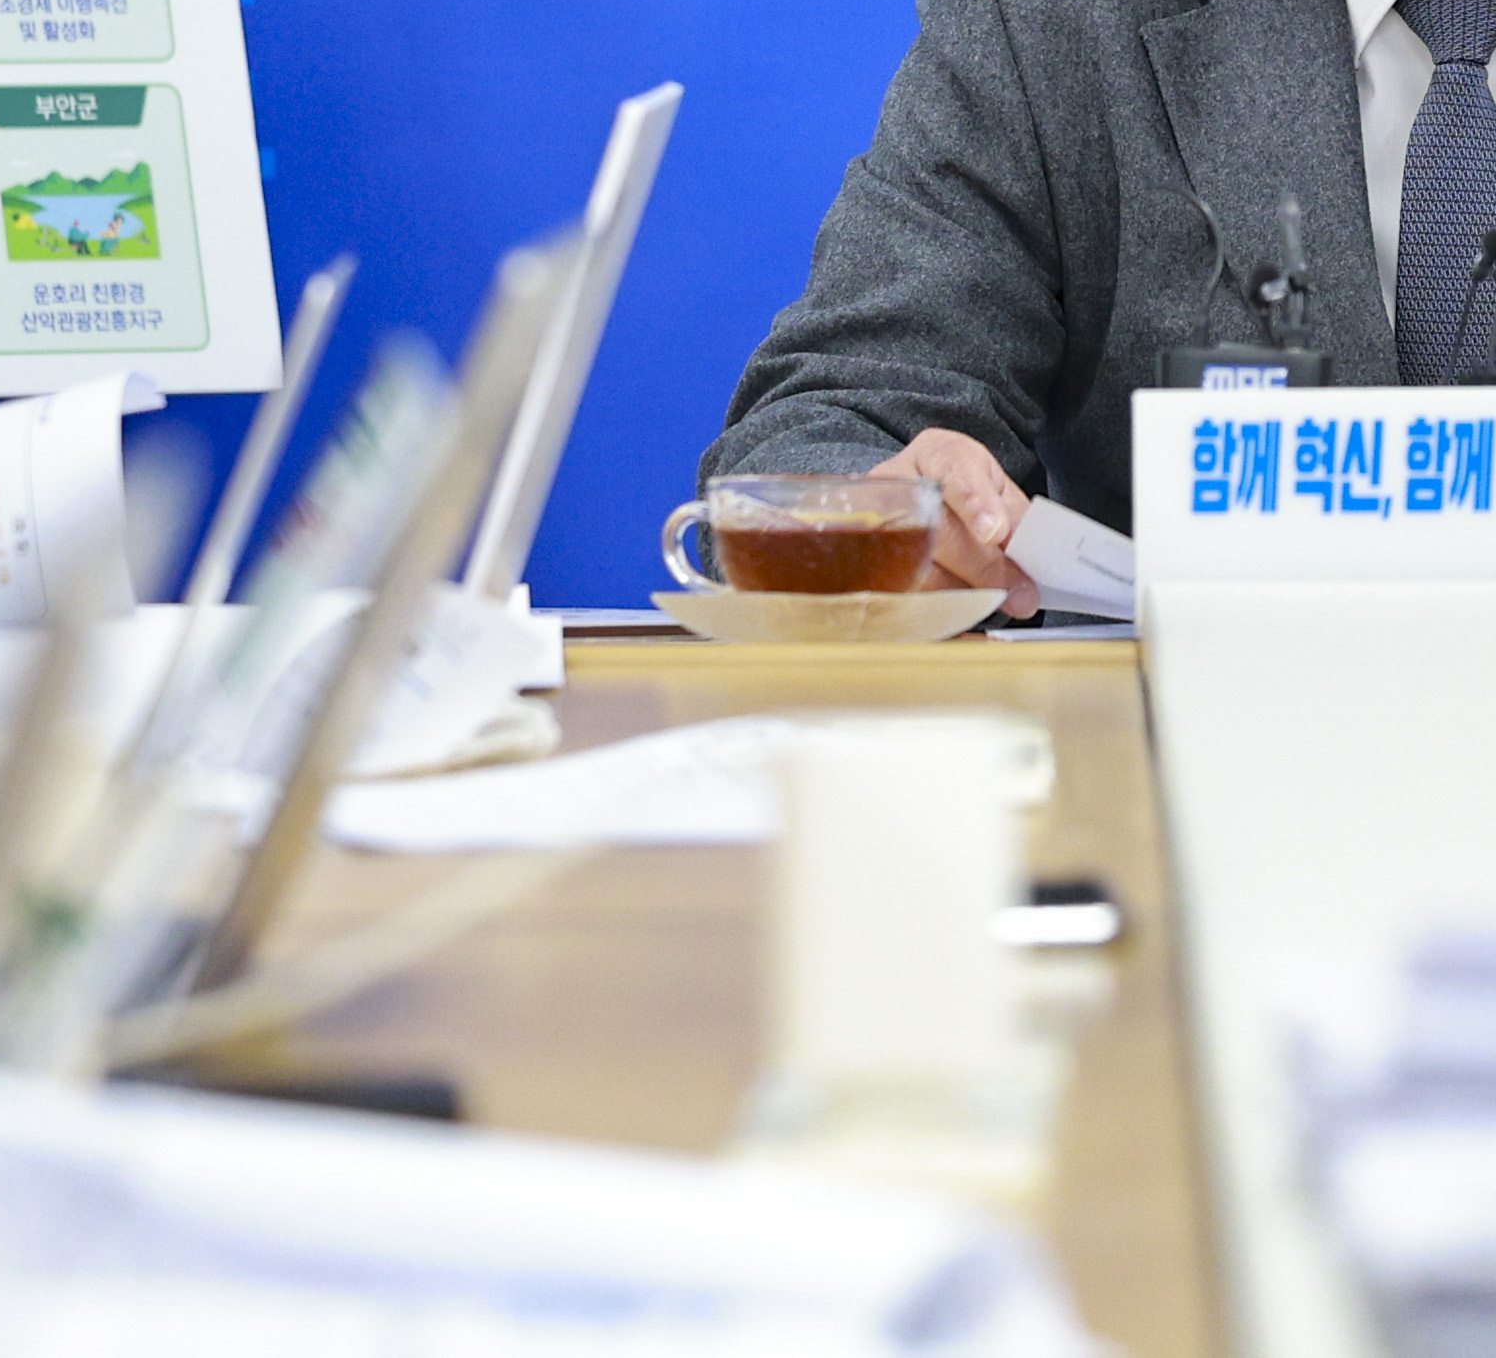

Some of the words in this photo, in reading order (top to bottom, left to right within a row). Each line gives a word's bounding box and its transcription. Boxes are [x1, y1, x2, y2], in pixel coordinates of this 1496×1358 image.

[34, 93, 99, 121] 부안군
[92, 282, 145, 306] 친환경
[1191, 418, 1281, 515] 함께
[1294, 417, 1392, 522] 혁신,
[1405, 418, 1495, 514] 함께
